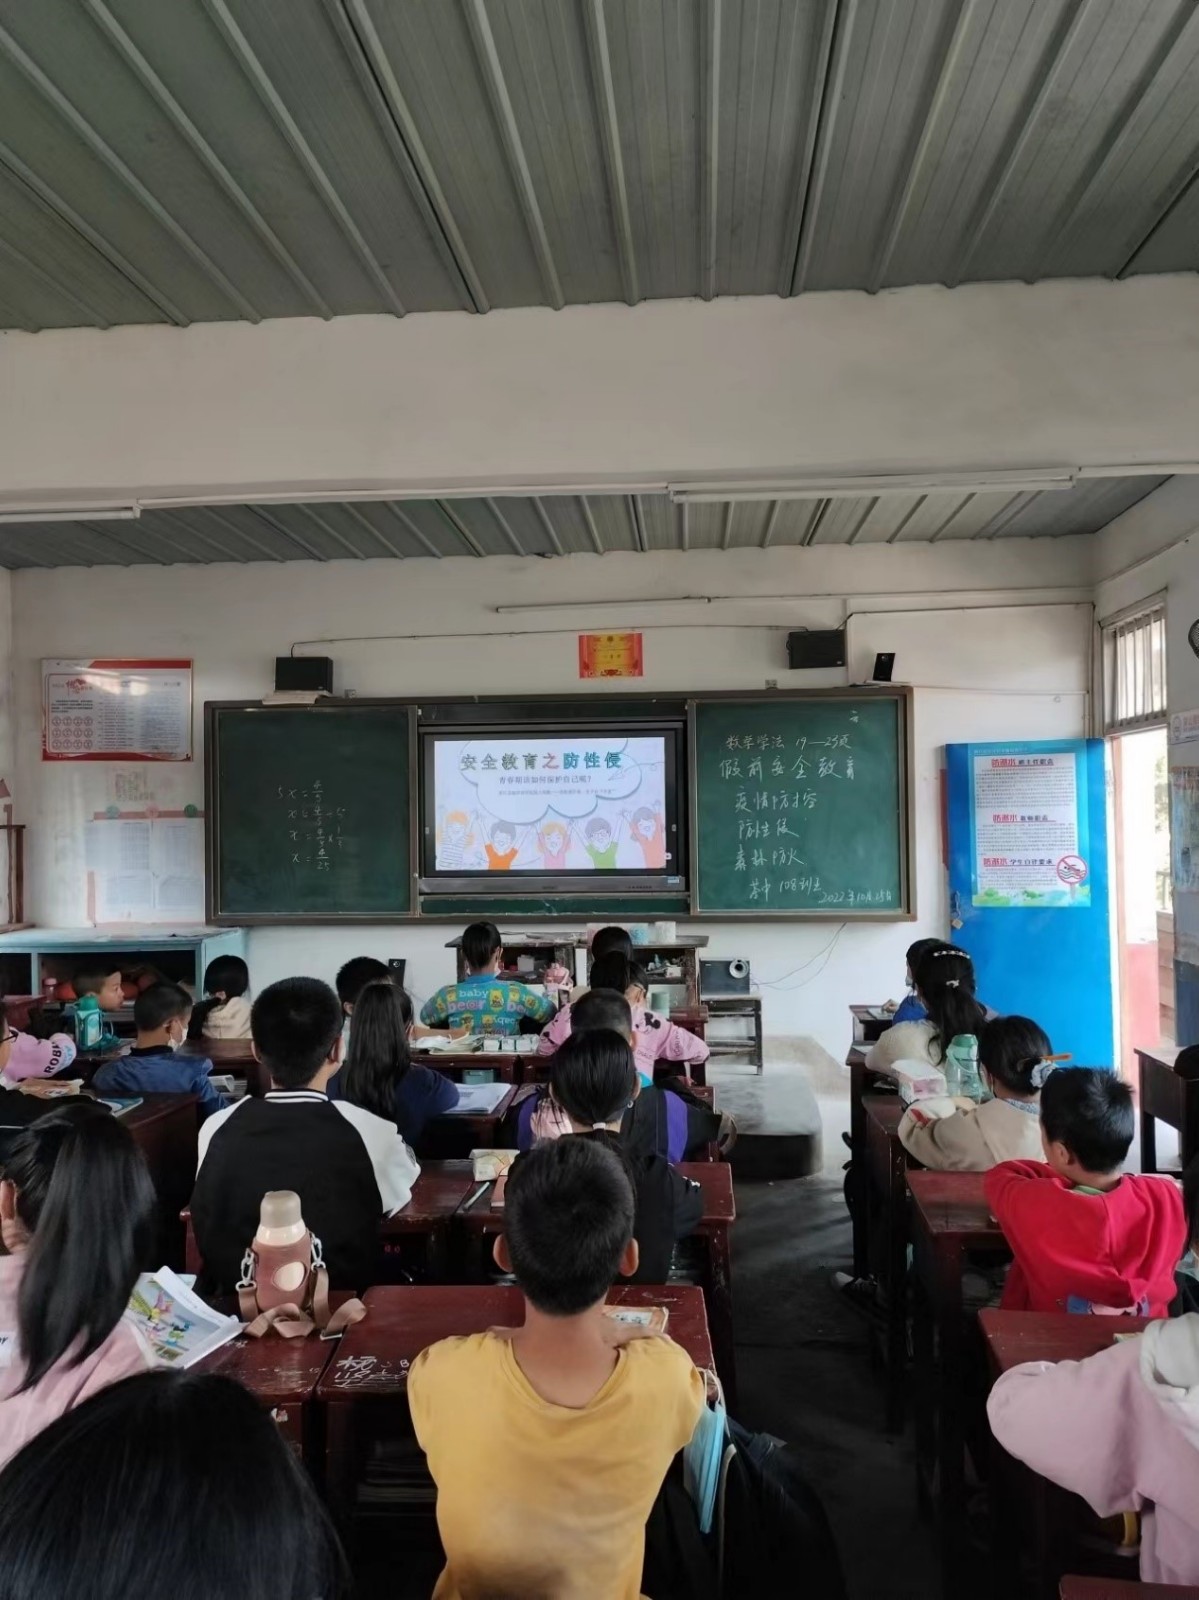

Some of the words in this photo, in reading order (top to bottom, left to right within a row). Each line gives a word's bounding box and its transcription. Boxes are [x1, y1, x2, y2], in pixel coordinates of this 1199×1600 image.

[460, 751, 622, 771] 安全教育之防性侵
[719, 755, 855, 782] 假前安全教育
[735, 786, 817, 813] 疫情防控
[739, 818, 800, 840] 防性侵
[734, 844, 805, 871] 森林防火
[459, 989, 488, 999] baby
